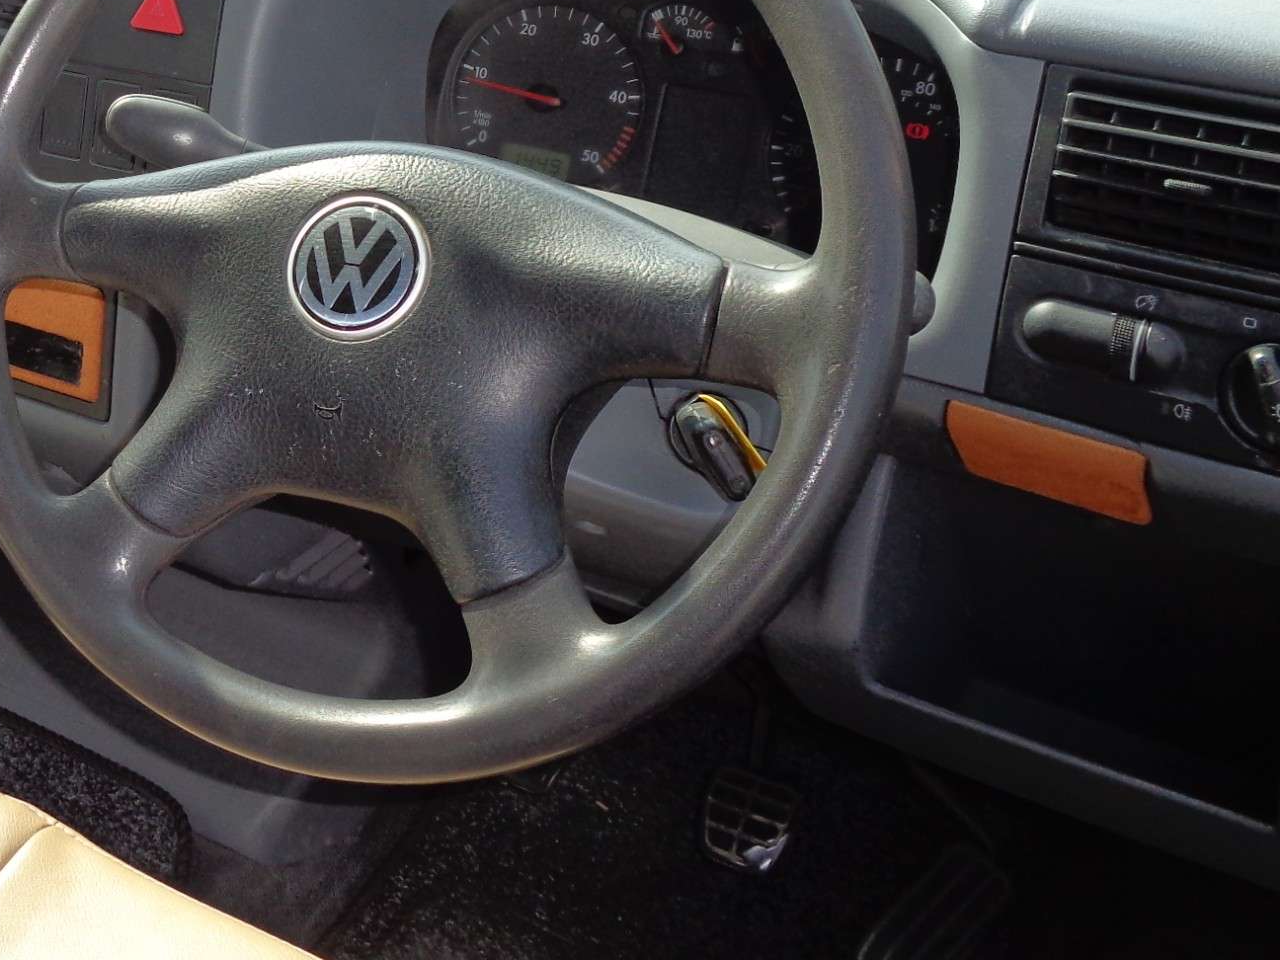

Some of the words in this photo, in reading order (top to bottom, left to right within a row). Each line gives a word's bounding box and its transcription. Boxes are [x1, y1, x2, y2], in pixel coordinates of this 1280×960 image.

[674, 16, 688, 26] 90
[520, 22, 537, 36] 20
[581, 31, 600, 47] 30
[474, 66, 488, 79] 10
[914, 81, 936, 96] 80
[608, 90, 627, 104] 40
[478, 130, 487, 143] 0
[580, 149, 599, 163] 50
